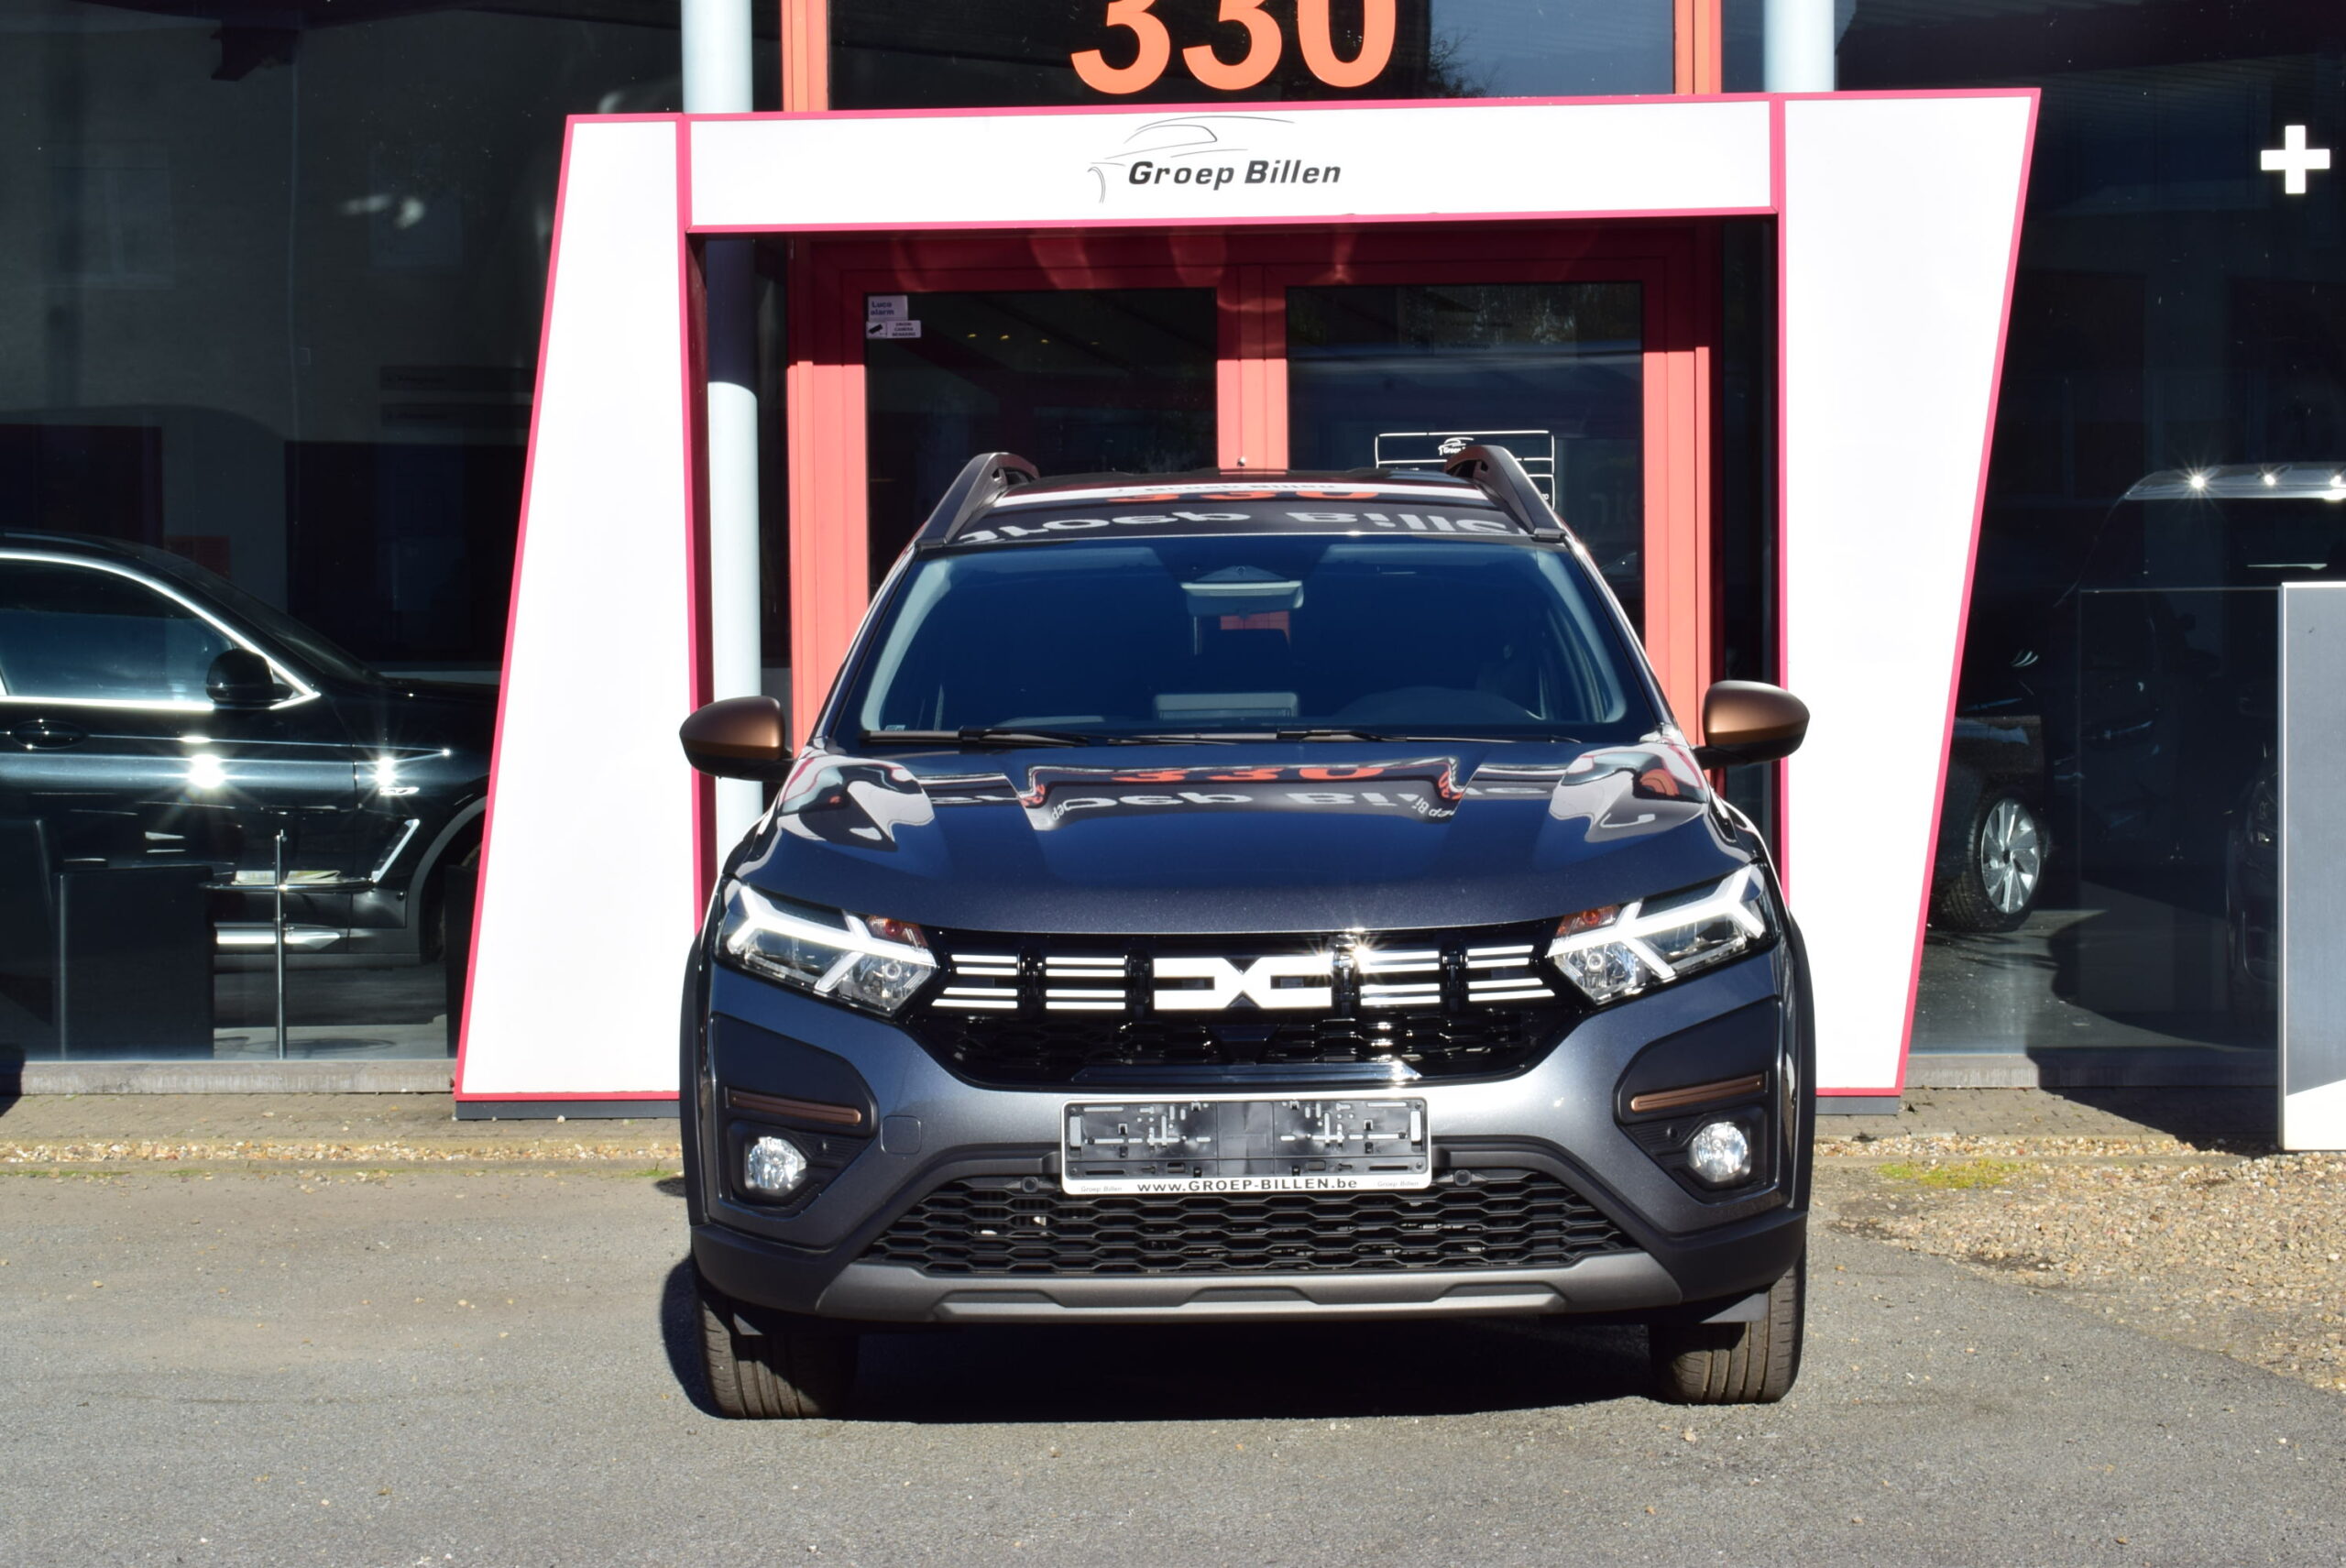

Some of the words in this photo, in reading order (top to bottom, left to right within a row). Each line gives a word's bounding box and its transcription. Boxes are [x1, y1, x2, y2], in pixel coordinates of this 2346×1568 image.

[1070, 0, 1397, 94] 330
[1128, 160, 1234, 191] Groep
[1244, 159, 1342, 183] Billen
[1136, 1178, 1358, 1192] www.GROEP-BILLEN.be
